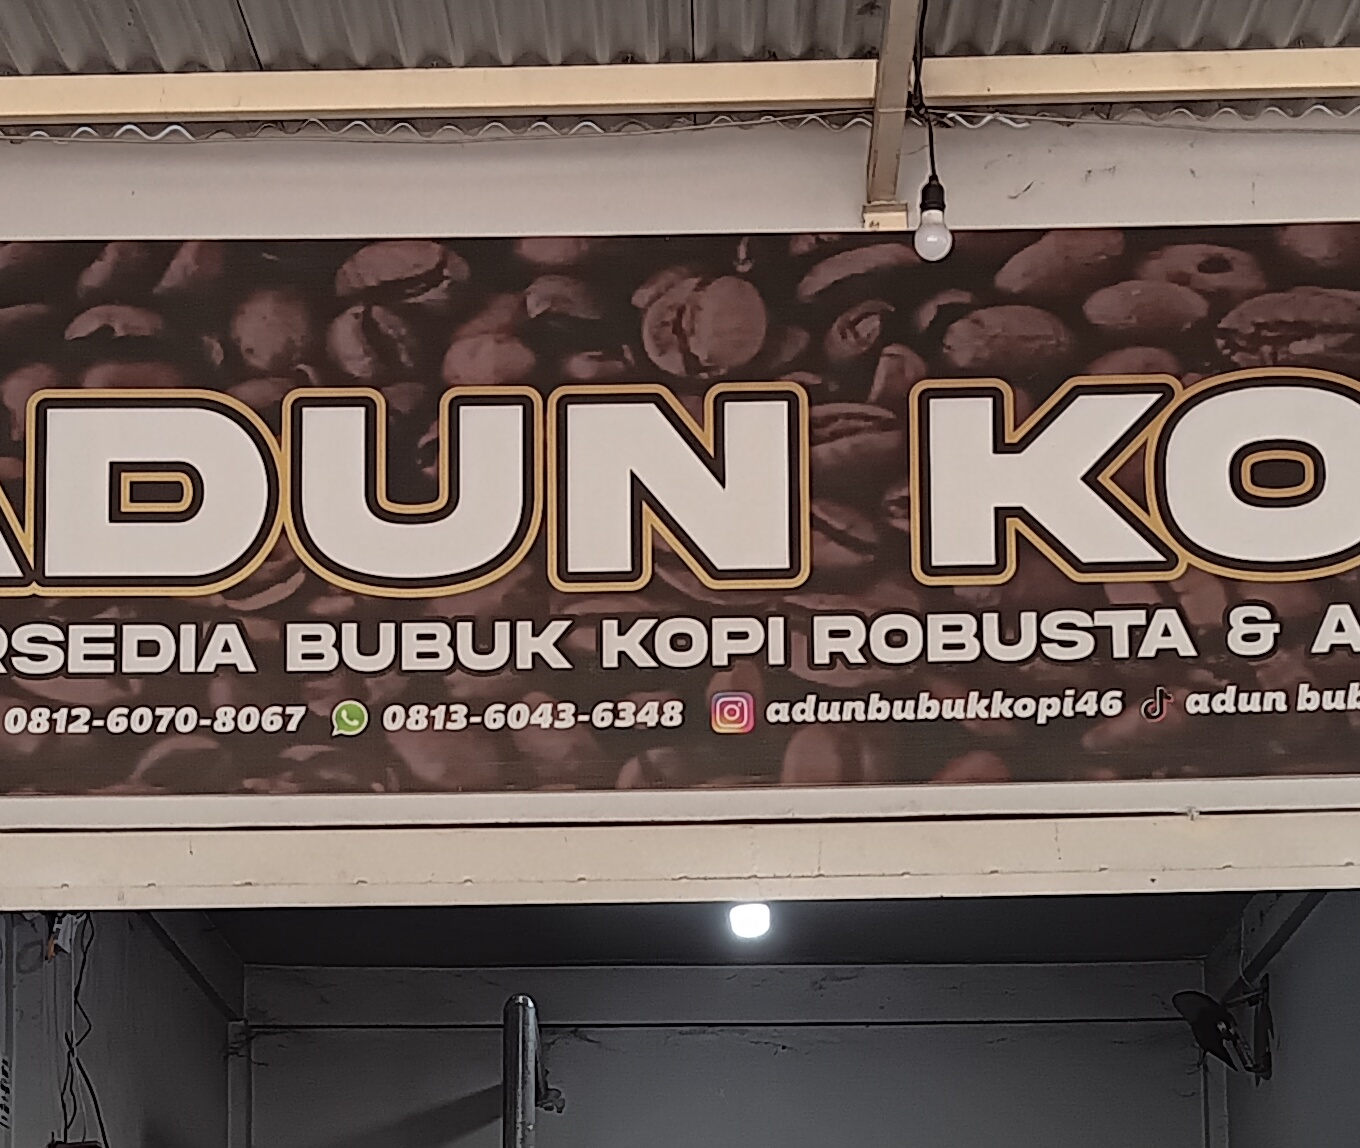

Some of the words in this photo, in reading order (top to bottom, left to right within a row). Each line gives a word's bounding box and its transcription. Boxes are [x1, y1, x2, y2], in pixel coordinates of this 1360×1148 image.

[284, 616, 572, 675] BUBUK
[599, 614, 787, 669] KOPI
[811, 607, 1199, 667] ROBUSTA
[1225, 605, 1281, 657] &
[382, 699, 685, 733] 0813-6043-6348
[763, 688, 1124, 727] adunbubukkopi46
[1183, 685, 1288, 714] adun
[2, 703, 308, 736] 0812-6070-8067
